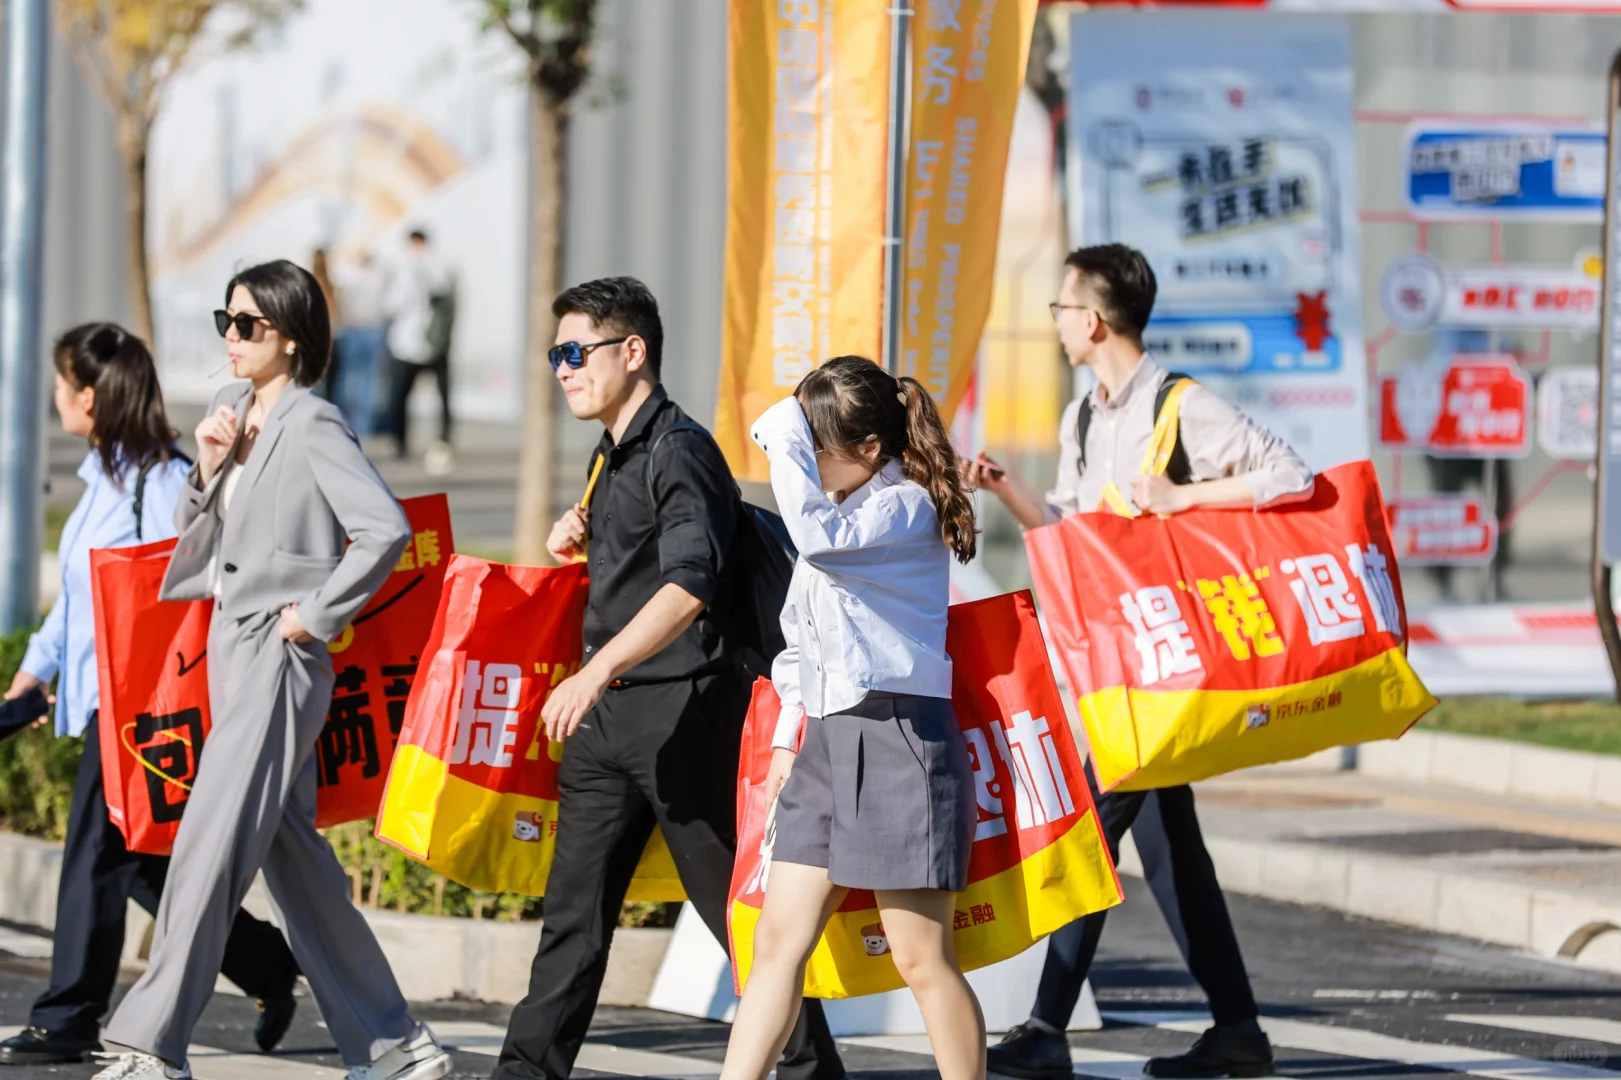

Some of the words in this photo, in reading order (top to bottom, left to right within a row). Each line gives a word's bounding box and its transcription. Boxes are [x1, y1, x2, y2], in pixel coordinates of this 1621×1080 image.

[945, 116, 979, 224] SHARED
[1276, 690, 1342, 720] 京东金融
